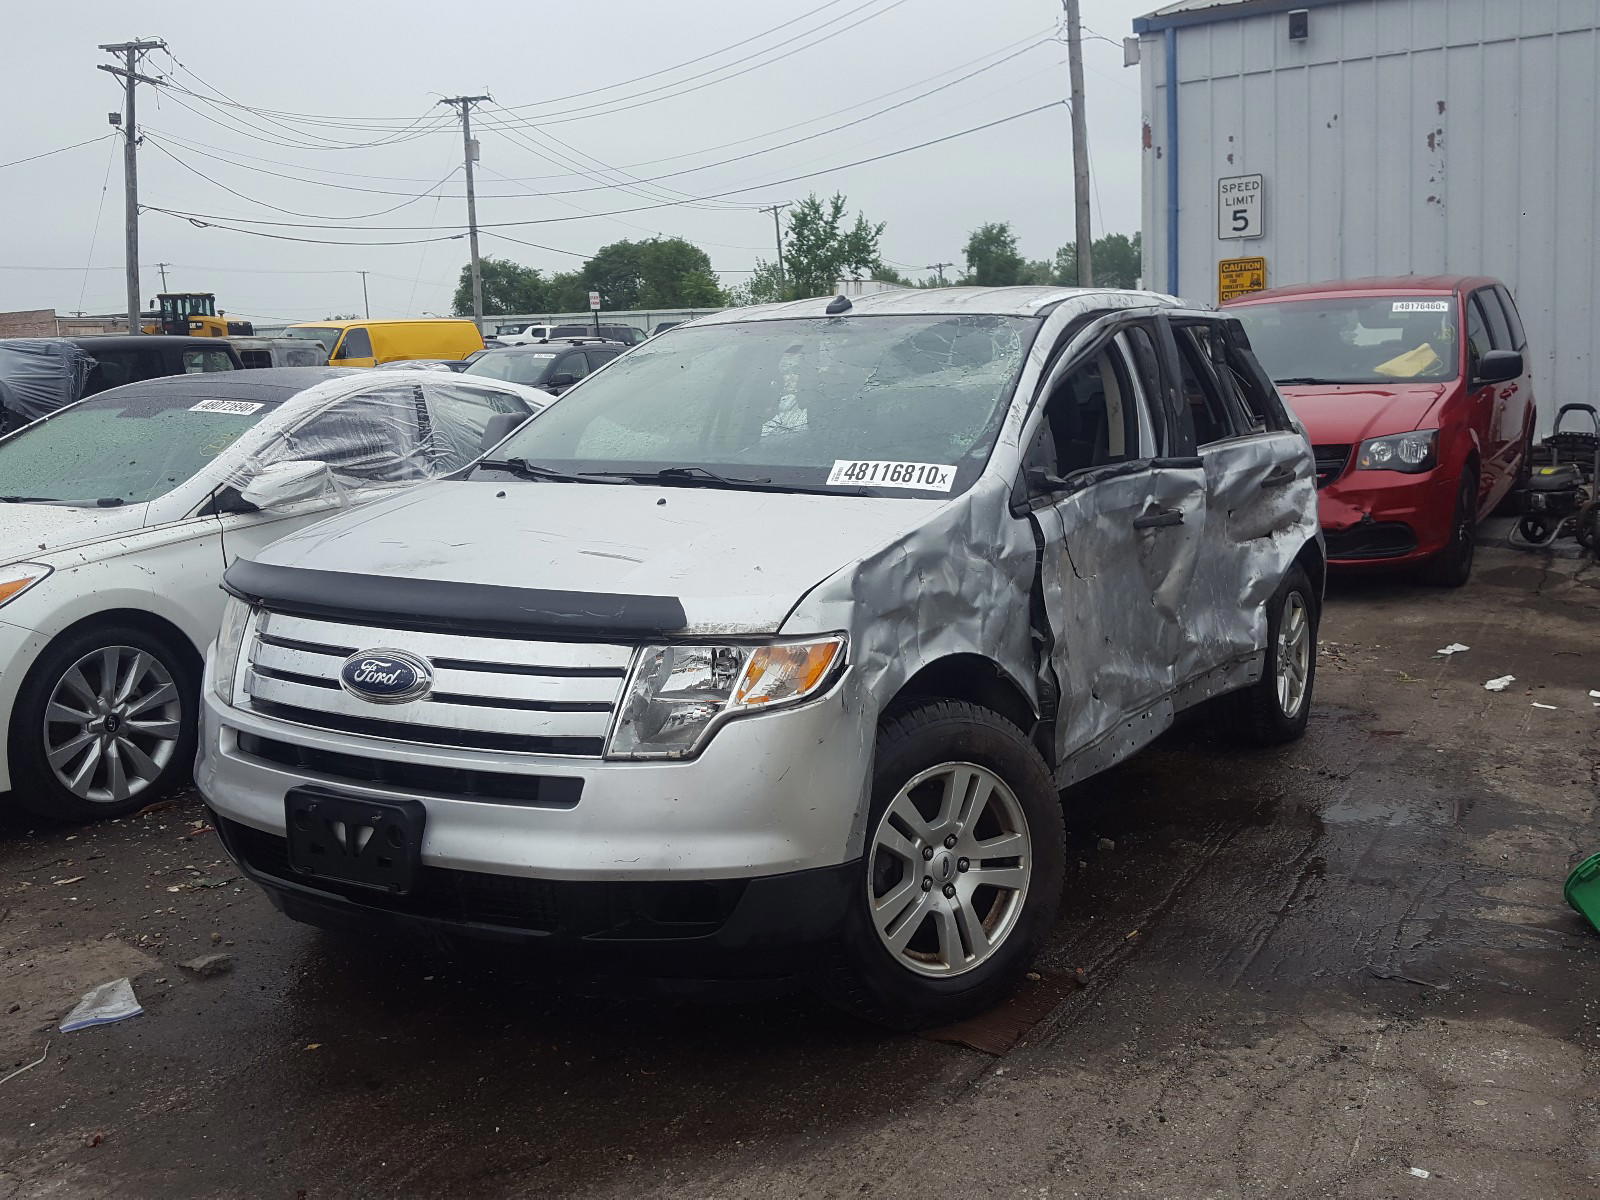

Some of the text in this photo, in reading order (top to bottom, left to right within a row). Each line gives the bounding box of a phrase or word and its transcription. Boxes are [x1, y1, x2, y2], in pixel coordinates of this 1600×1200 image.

[1222, 181, 1260, 193] SPEED
[1225, 194, 1255, 206] LIMIT
[1232, 208, 1249, 231] 5
[1223, 261, 1261, 272] CAUTION
[354, 659, 402, 686] Ford
